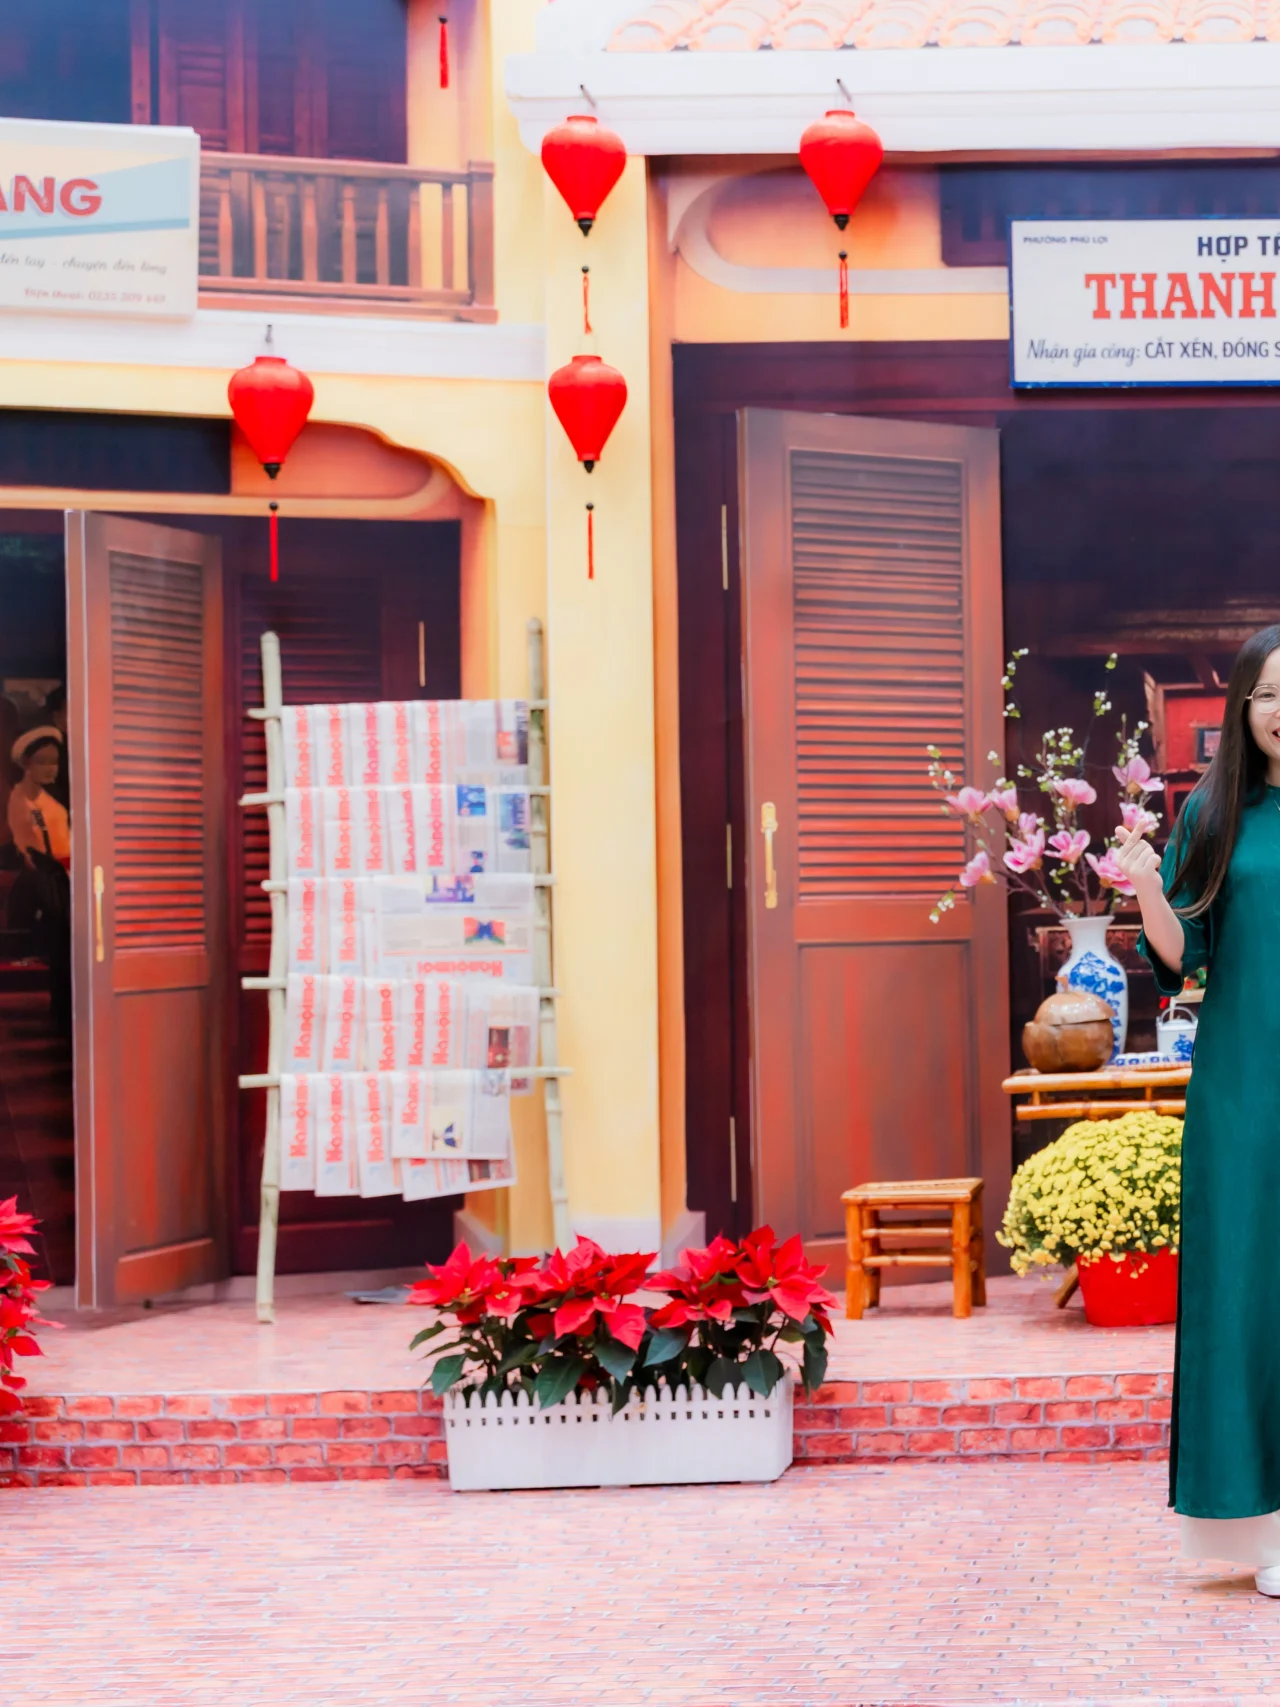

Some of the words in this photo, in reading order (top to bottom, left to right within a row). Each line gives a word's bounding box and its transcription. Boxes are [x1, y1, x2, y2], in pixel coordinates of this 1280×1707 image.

[0, 175, 103, 217] NG
[1197, 235, 1249, 263] HỢP
[1085, 272, 1276, 319] THANH
[1027, 338, 1069, 362] Nhận
[1073, 343, 1097, 367] gia
[1101, 342, 1140, 367] công:
[1145, 337, 1174, 358] CẮT
[1180, 337, 1217, 358] XÉN,
[1222, 337, 1269, 358] ĐÓNG
